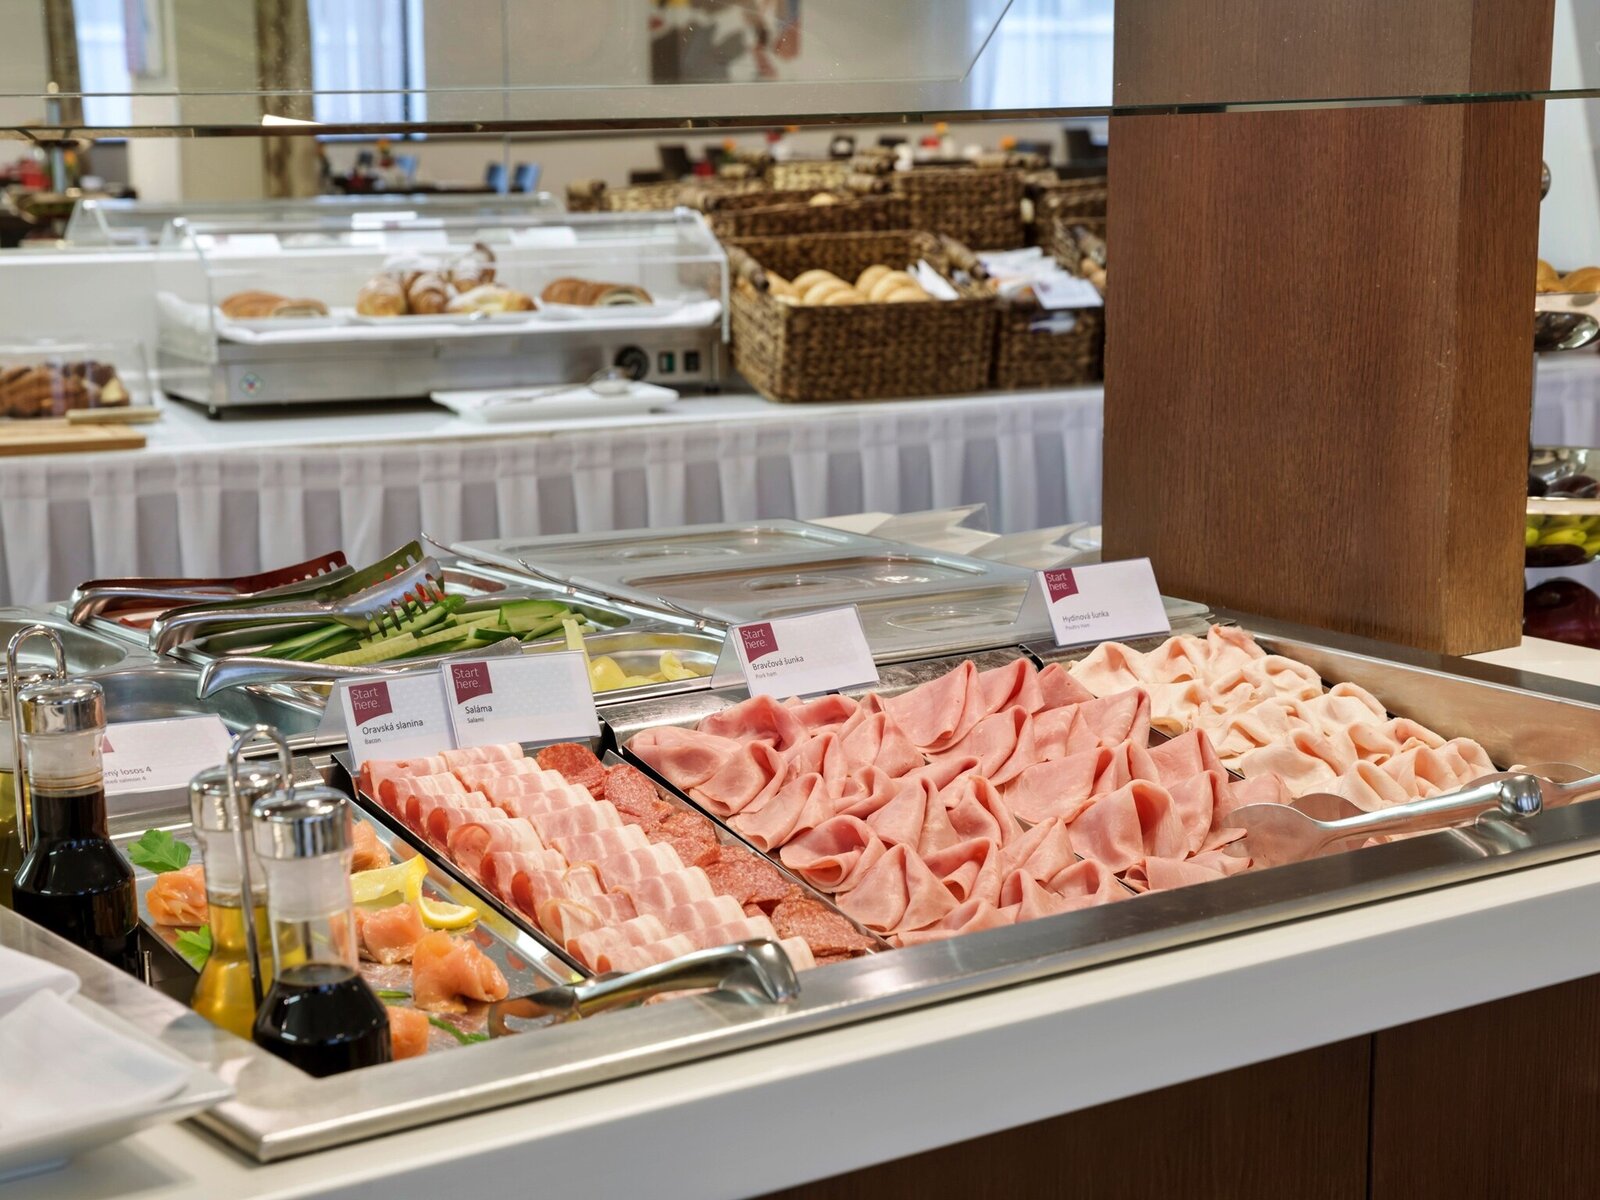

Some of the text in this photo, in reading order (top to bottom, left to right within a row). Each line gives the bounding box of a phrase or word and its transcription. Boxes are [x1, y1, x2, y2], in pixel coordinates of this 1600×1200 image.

[1046, 572, 1068, 582] Start
[1048, 582, 1069, 591] here.
[1062, 610, 1110, 622] Hydinová šunka
[742, 628, 766, 640] Start
[744, 639, 768, 648] here.
[752, 656, 804, 670] Bravčová šunka
[454, 668, 480, 679] Start
[456, 679, 481, 688] here.
[352, 688, 378, 700] Start
[354, 699, 380, 710] here.
[464, 704, 493, 714] Saláma
[362, 720, 424, 735] Oravská slanina
[120, 768, 144, 776] losos
